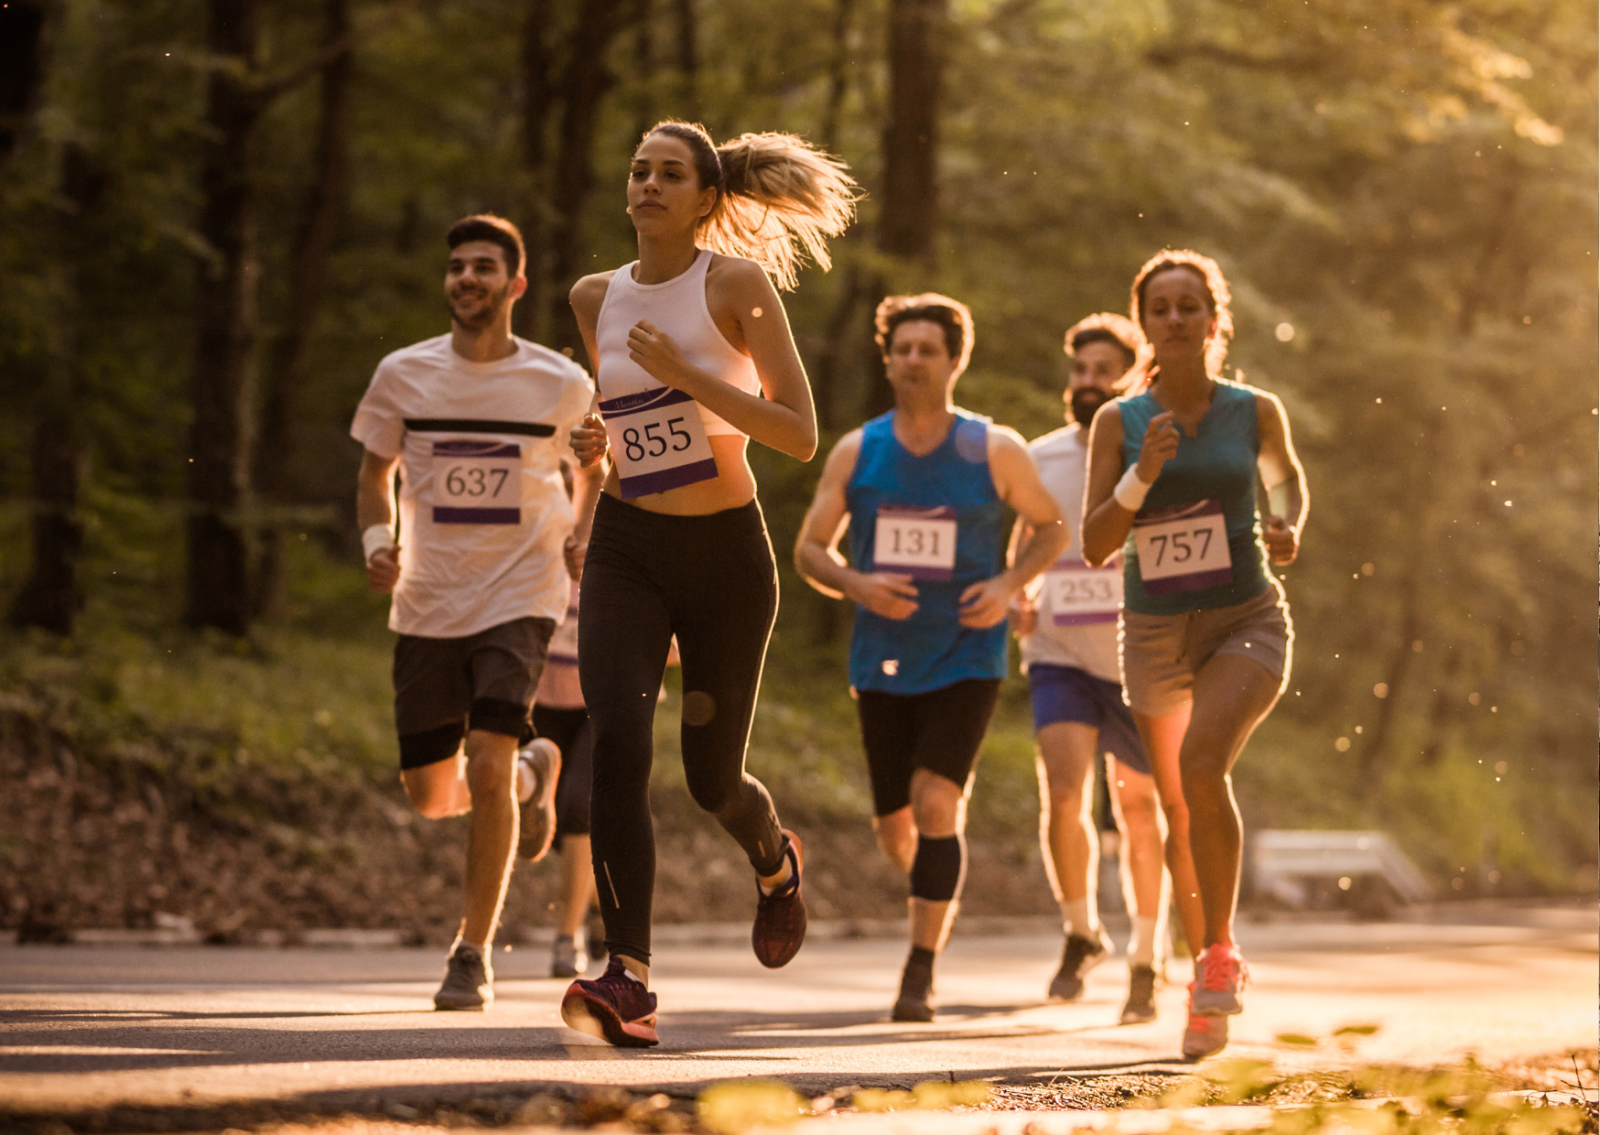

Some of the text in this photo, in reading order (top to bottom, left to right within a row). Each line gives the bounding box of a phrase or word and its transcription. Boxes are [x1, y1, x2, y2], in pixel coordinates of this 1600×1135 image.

[623, 417, 691, 462] 855
[446, 466, 509, 497] 637
[891, 528, 940, 556] 131
[1150, 528, 1213, 567] 757
[1060, 577, 1114, 604] 253
